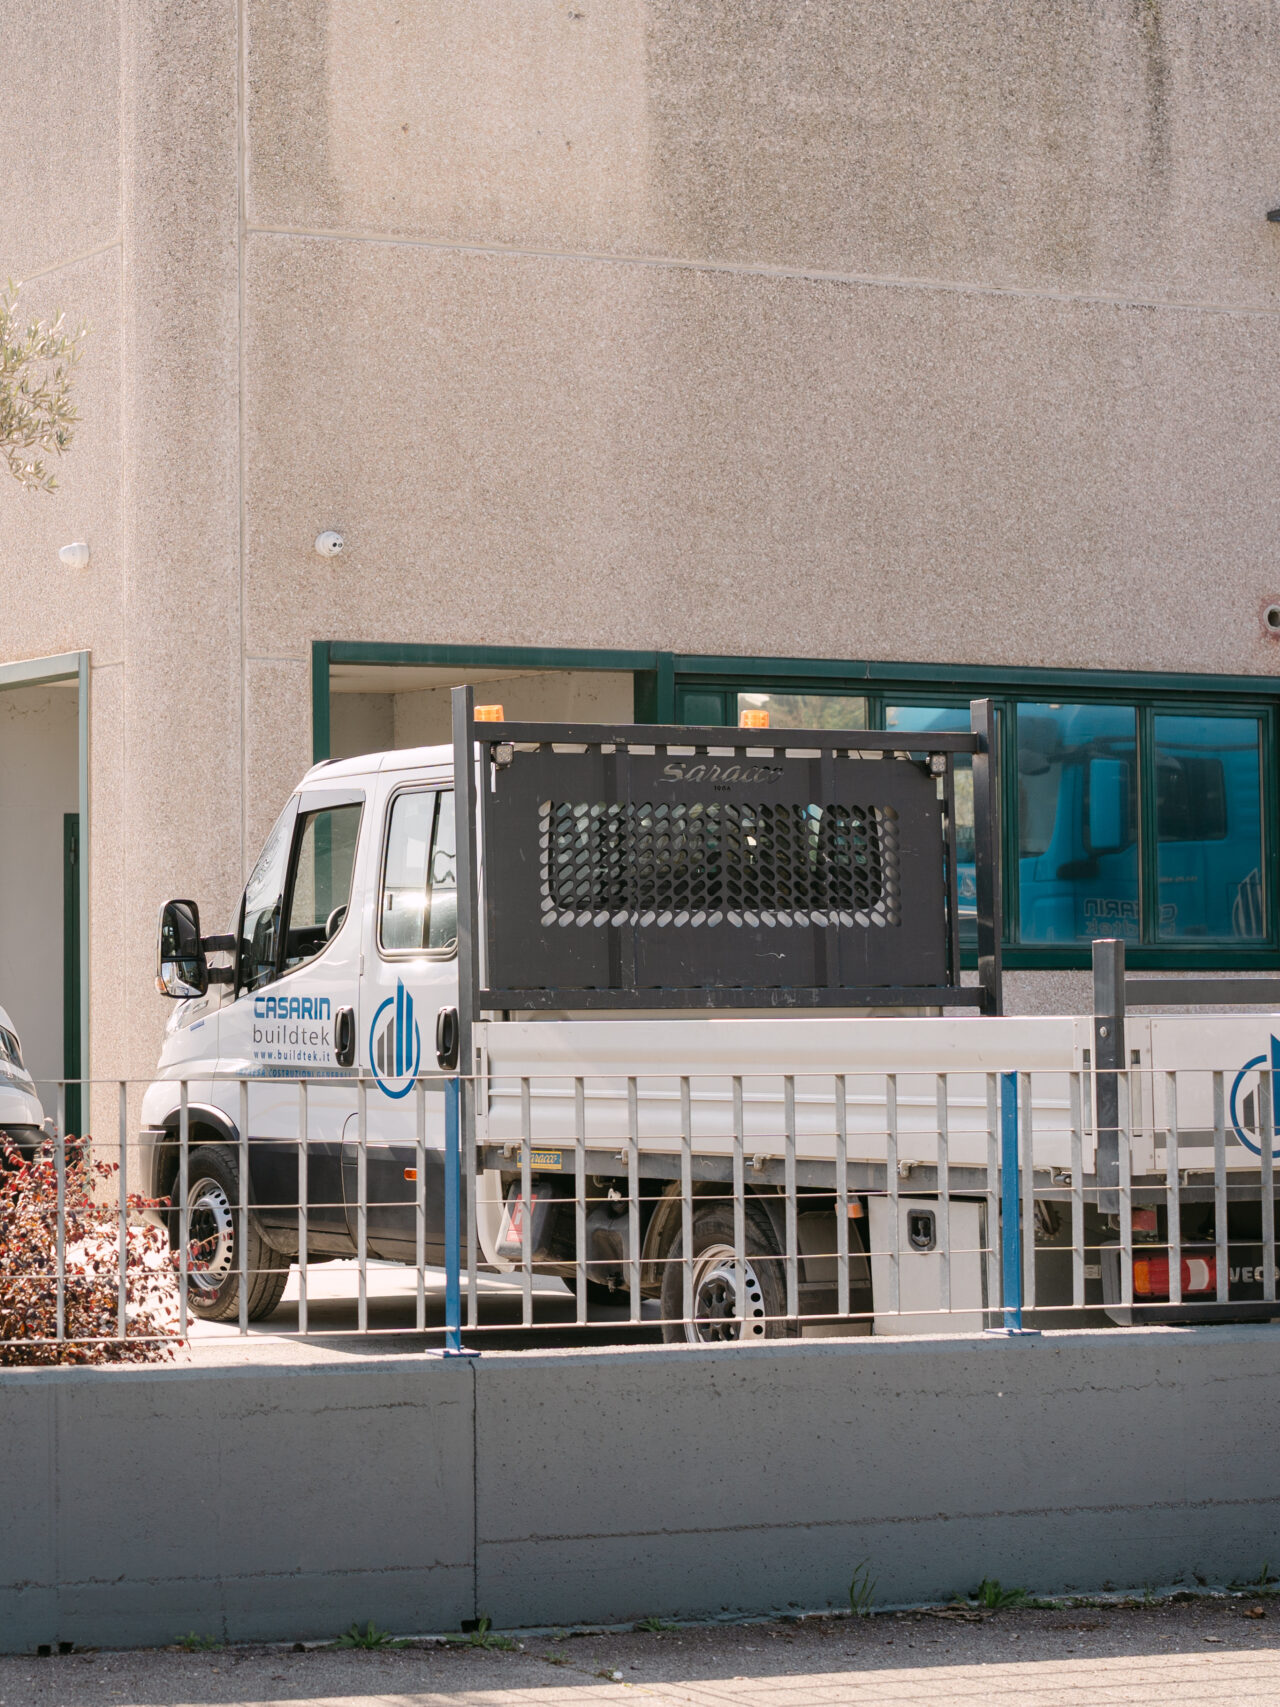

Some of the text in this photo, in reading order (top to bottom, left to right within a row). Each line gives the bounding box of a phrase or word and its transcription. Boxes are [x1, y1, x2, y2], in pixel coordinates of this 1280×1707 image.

[660, 762, 784, 784] Saracco
[254, 996, 331, 1020] CASARIN
[253, 1023, 330, 1046] buildtek
[253, 1049, 330, 1062] www.buildtek.it
